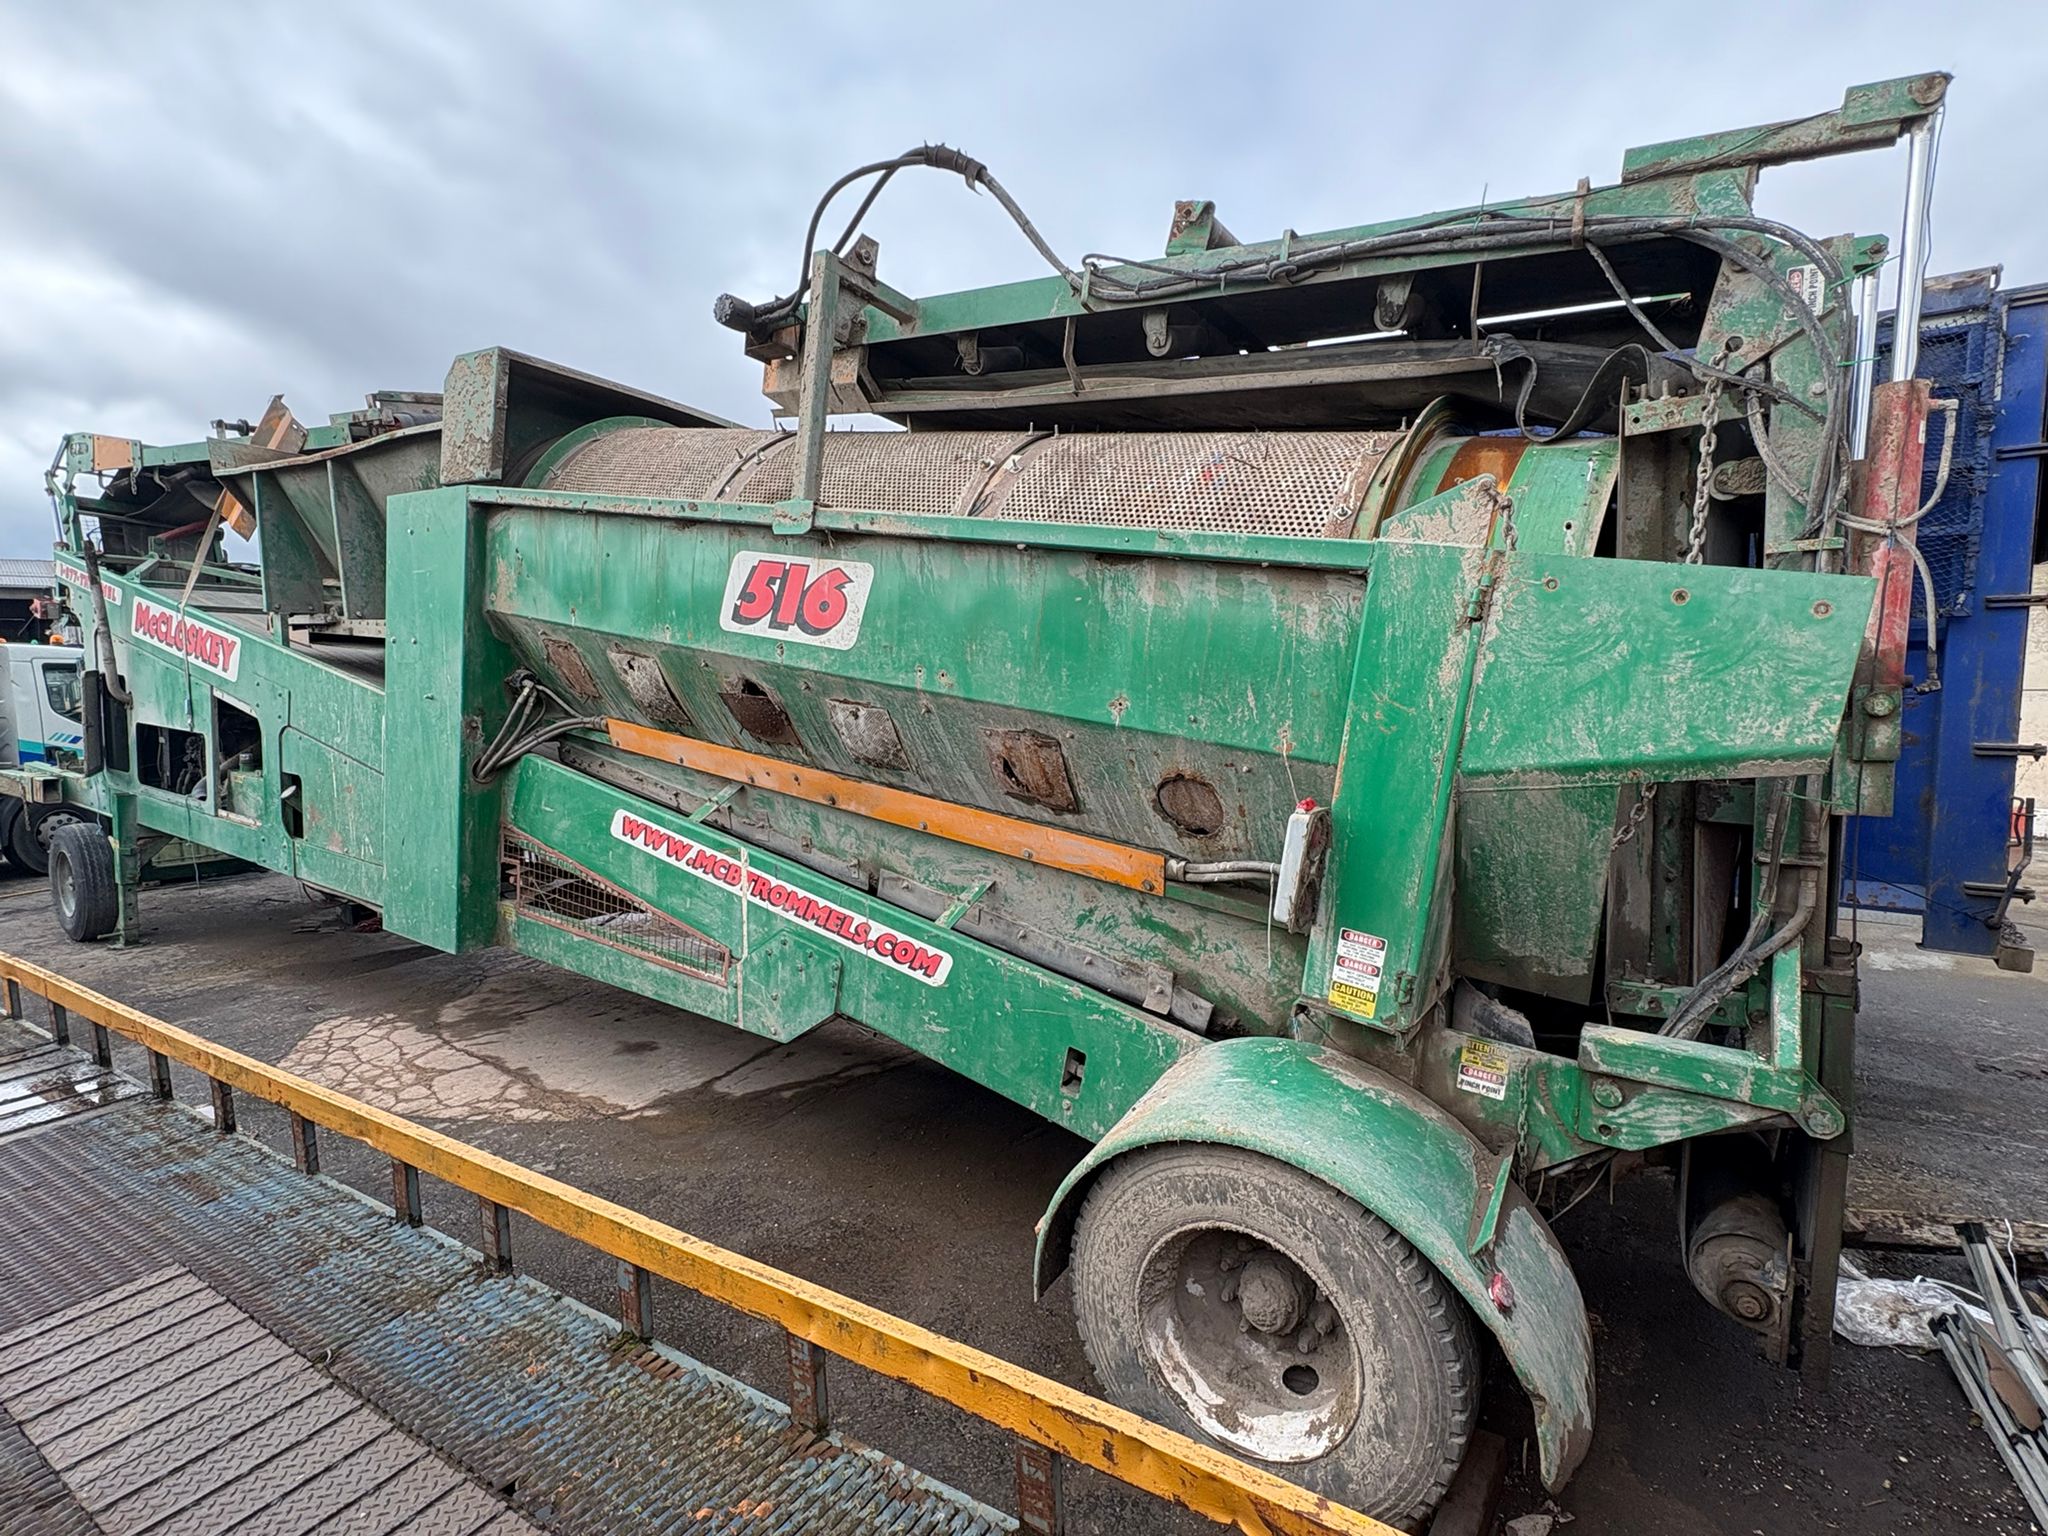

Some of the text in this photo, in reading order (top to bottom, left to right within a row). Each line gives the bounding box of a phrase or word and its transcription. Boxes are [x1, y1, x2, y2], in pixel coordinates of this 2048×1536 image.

[1808, 269, 1819, 289] POINT
[731, 559, 854, 636] 516
[135, 602, 237, 673] McCLOSKEY
[1346, 931, 1379, 948] DANGER
[1342, 957, 1374, 974] DANGER
[1333, 982, 1375, 1001] CAUTION
[1465, 1039, 1509, 1058] ATTENTION
[1467, 1067, 1499, 1083] DANGER
[1459, 1079, 1502, 1095] PINCH POINT
